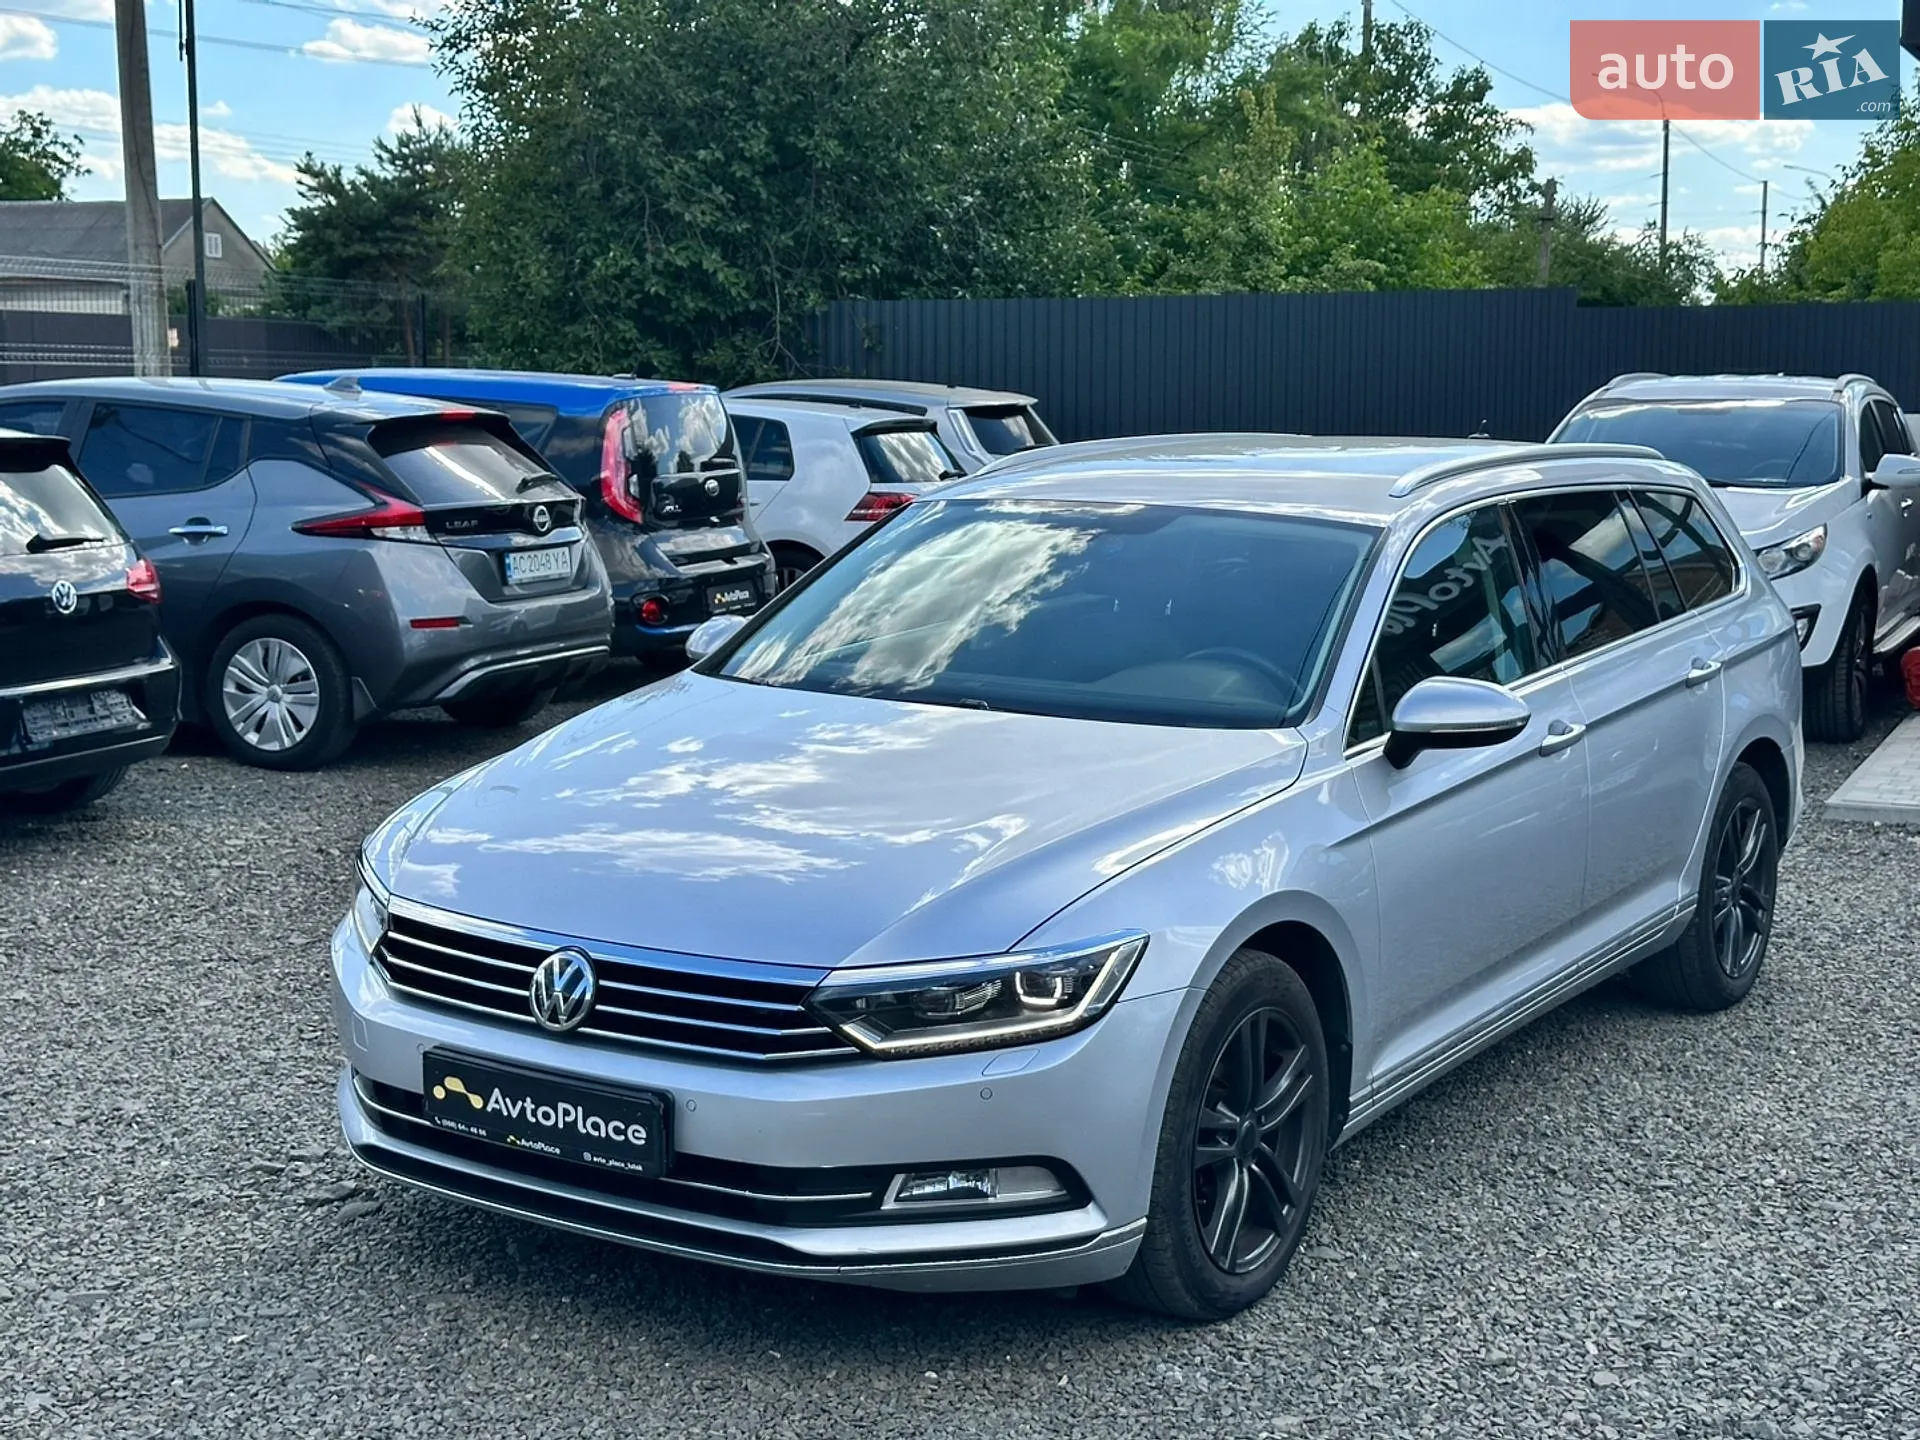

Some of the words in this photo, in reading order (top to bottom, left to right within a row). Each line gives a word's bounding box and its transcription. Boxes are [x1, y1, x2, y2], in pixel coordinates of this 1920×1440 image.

[445, 520, 479, 529] LEAF
[486, 1087, 648, 1146] AvtoPlace
[521, 1138, 561, 1155] AvtoPlace
